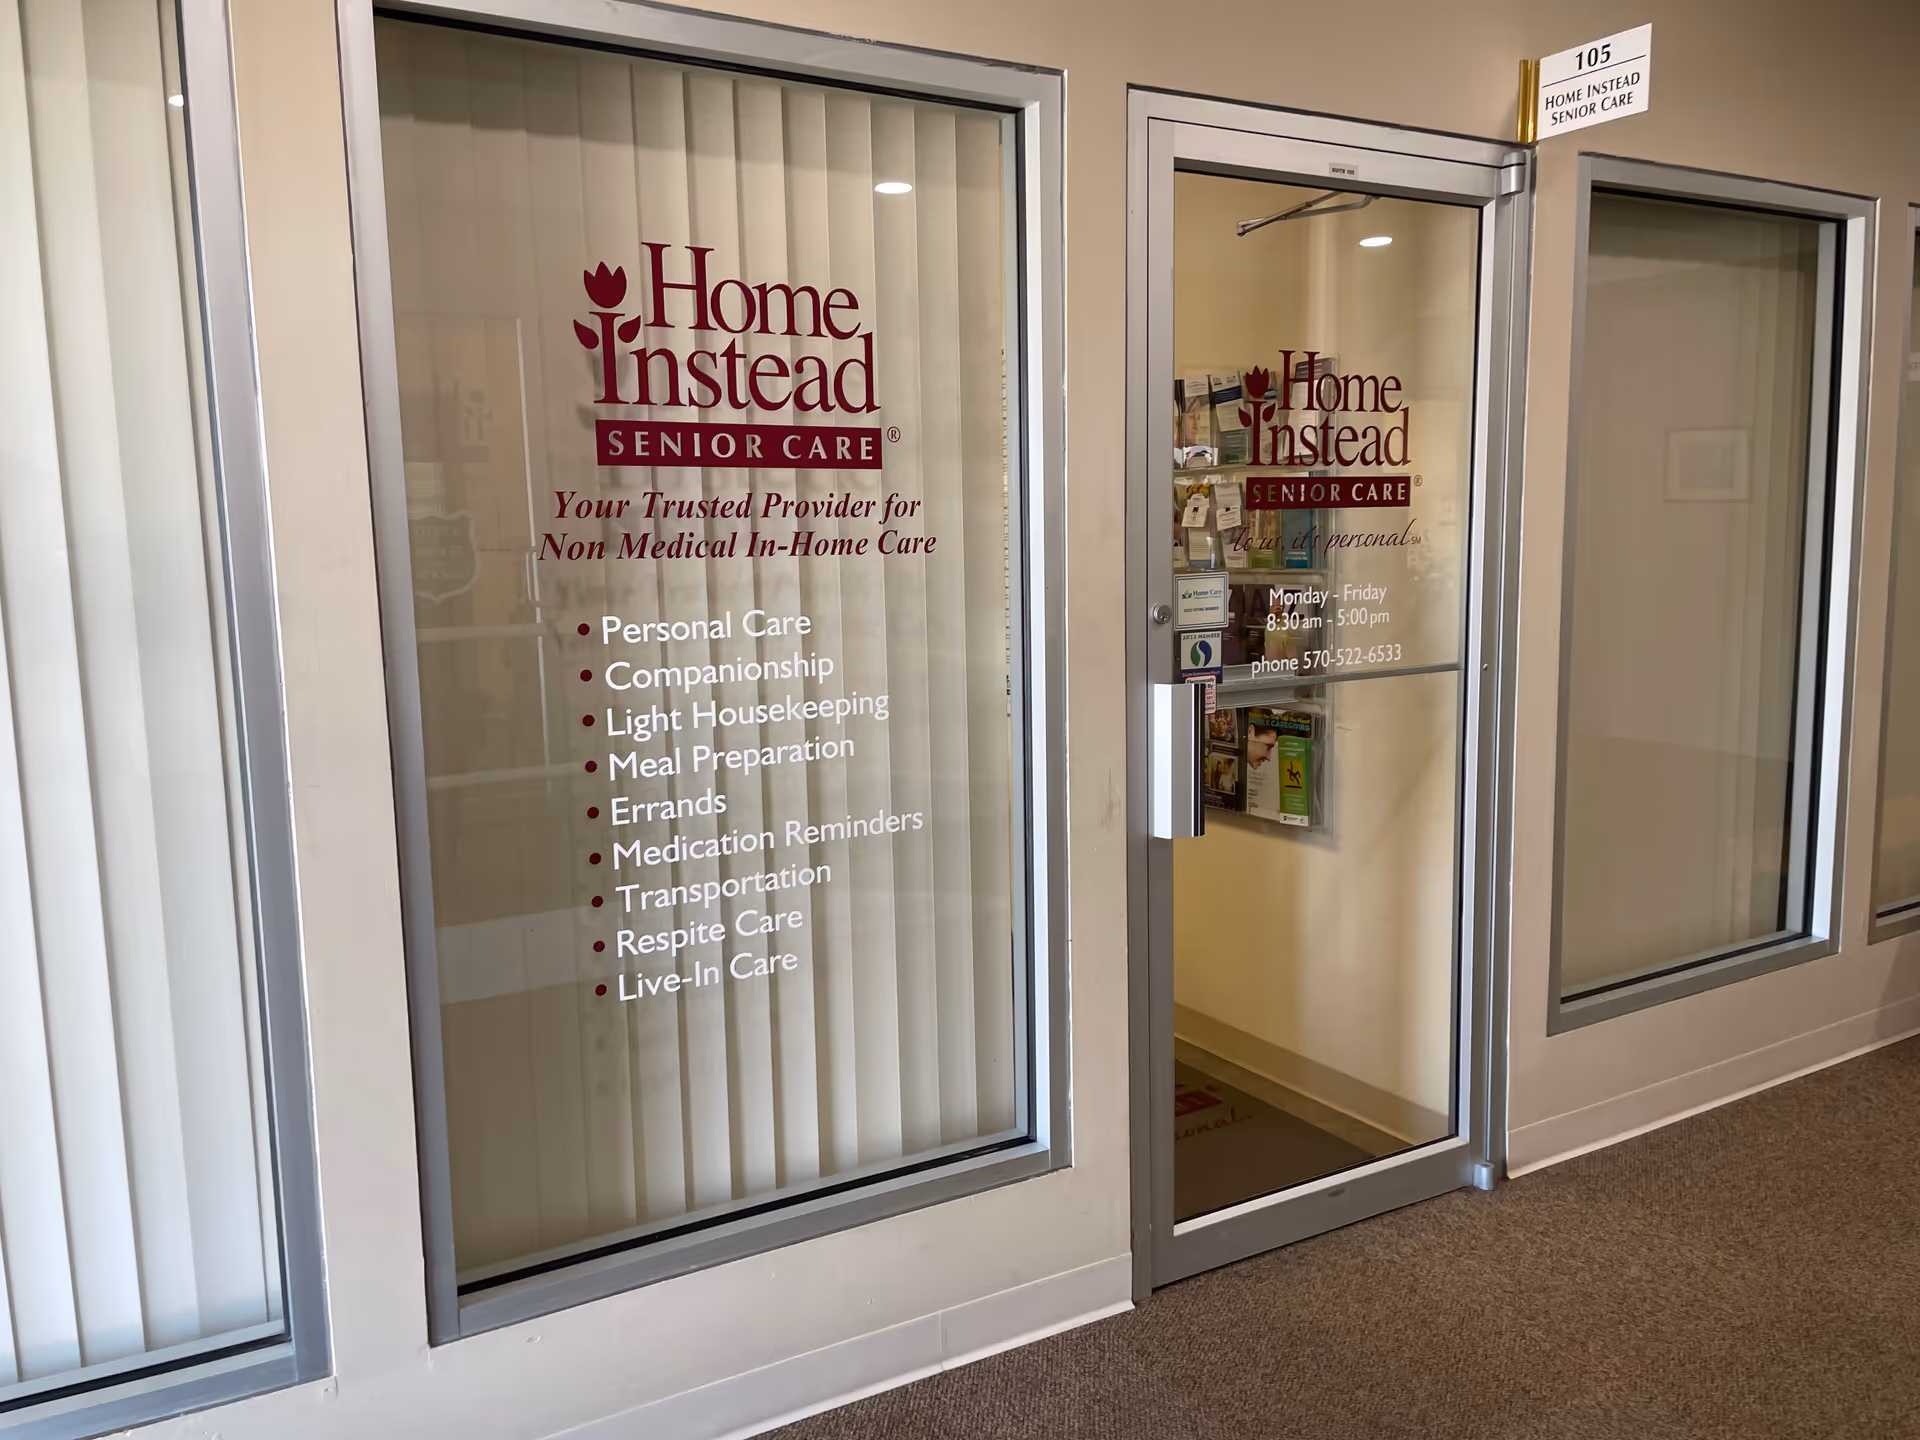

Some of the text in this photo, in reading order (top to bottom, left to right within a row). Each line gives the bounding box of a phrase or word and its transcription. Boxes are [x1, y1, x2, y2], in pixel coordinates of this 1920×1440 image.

[1575, 43, 1611, 70] 105
[1545, 72, 1640, 110] HOME INSTEAD
[1551, 91, 1634, 126] SENIOR CARE
[641, 242, 861, 340] Home
[588, 311, 881, 414] Instead
[1278, 350, 1403, 413] Home
[608, 430, 874, 461] SENIOR CARE
[1246, 401, 1412, 467] Instead
[554, 491, 921, 525] Your Trusted Provider for
[1252, 483, 1406, 503] SENIOR CARE
[538, 529, 937, 561] Non Medical In-Home Care
[1324, 518, 1417, 558] personal
[1269, 586, 1329, 608] Monday
[1343, 583, 1387, 605] Friday
[602, 609, 812, 645] Personal Care
[1266, 612, 1300, 632] 8:30
[1302, 616, 1322, 629] am
[1337, 608, 1368, 627] 5:00
[1369, 611, 1390, 629] pm
[605, 652, 834, 694] Companionship
[1251, 644, 1402, 678] phone 570-522-6533
[607, 691, 889, 742] Light Housekeeping
[609, 735, 855, 781] Meal Preparation
[611, 788, 727, 826] Errands
[613, 809, 924, 870] Medication Reminders
[615, 862, 832, 913] Transportation
[617, 909, 803, 958] Respite Care
[618, 951, 799, 1001] Live-In Care
